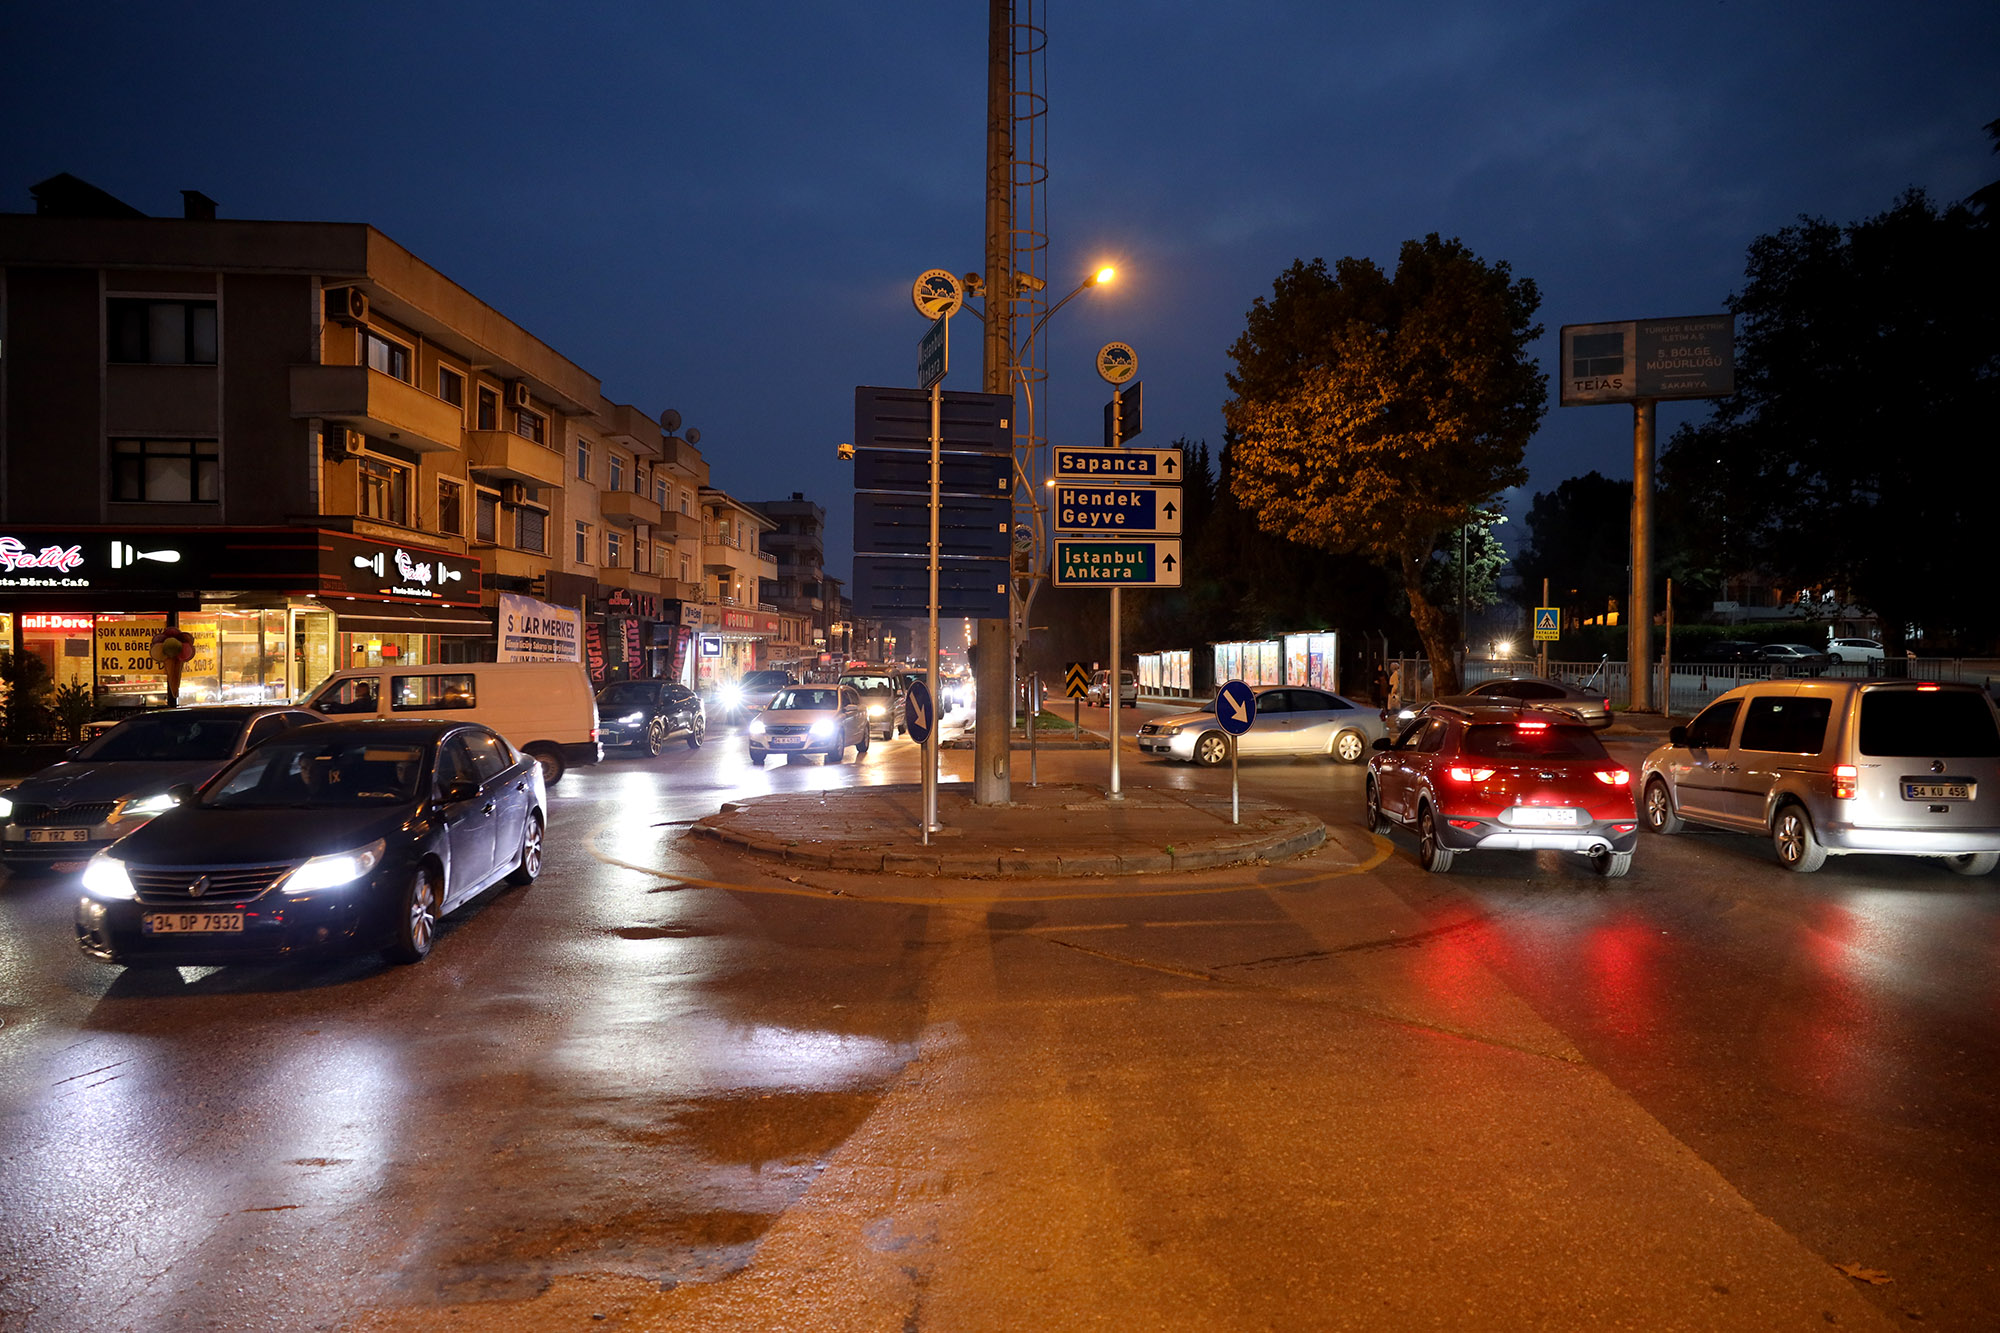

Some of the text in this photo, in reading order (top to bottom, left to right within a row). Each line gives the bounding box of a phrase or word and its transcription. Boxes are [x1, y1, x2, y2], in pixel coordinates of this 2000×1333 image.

[1658, 346, 1711, 358] 5. BÖLGE
[1646, 356, 1722, 370] MÜDÜRLÜĞÜ
[1574, 377, 1623, 391] TEİAŞ
[1660, 381, 1708, 390] SAKARYA
[1062, 455, 1148, 473] Sapanca
[1063, 490, 1142, 506] Hendek
[1062, 508, 1126, 527] Geyve
[1065, 547, 1144, 564] İstanbul
[1065, 565, 1133, 578] Ankara
[507, 614, 540, 635] SOLAR
[542, 618, 575, 639] MERKEZ
[98, 628, 116, 639] ŞOK
[104, 642, 122, 651] KOL
[101, 657, 123, 670] KG.
[128, 657, 153, 670] 200
[193, 659, 207, 672] 200
[1913, 787, 1967, 796] 54 KU 458
[31, 831, 85, 841] 07 YRZ 99
[155, 915, 240, 930] 34 DP 7932
